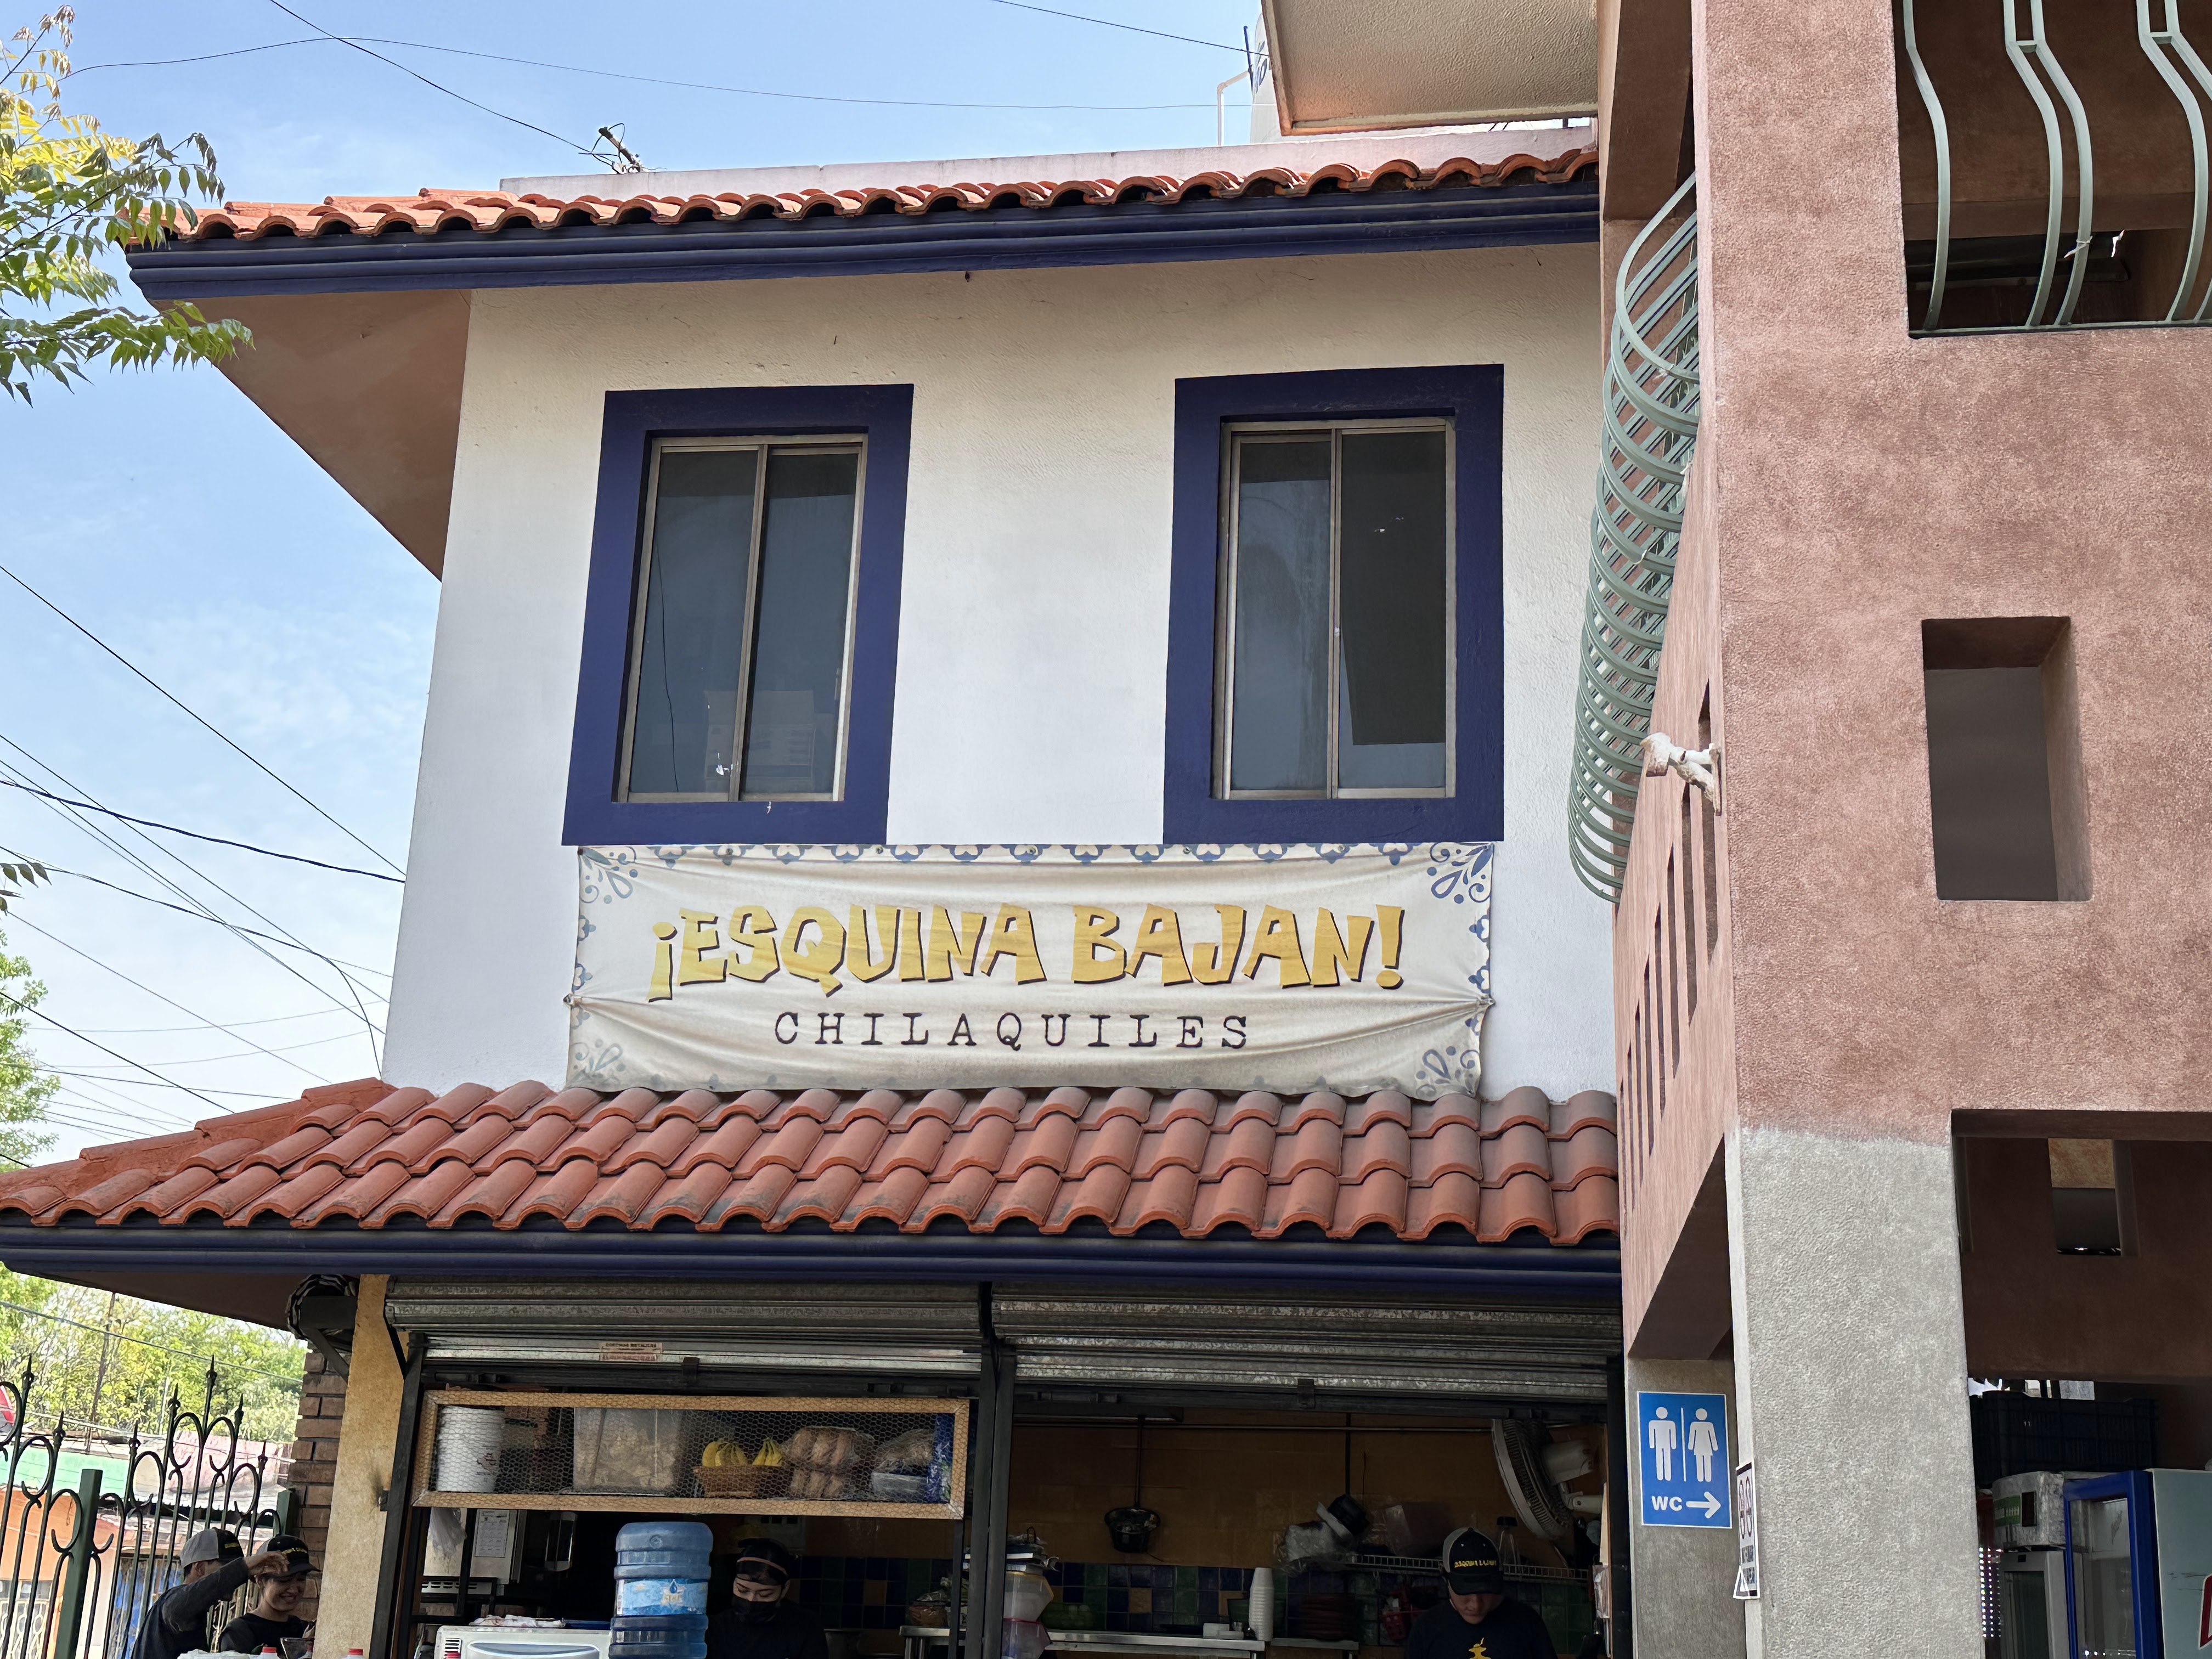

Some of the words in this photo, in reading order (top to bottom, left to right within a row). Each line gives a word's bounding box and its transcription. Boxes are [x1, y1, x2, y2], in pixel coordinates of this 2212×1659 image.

[647, 905, 1047, 1003] ¡ESQUINA
[1072, 904, 1406, 991] BAJAN!
[774, 1012, 1250, 1052] CHILAQUILES
[1651, 1496, 1683, 1511] WC
